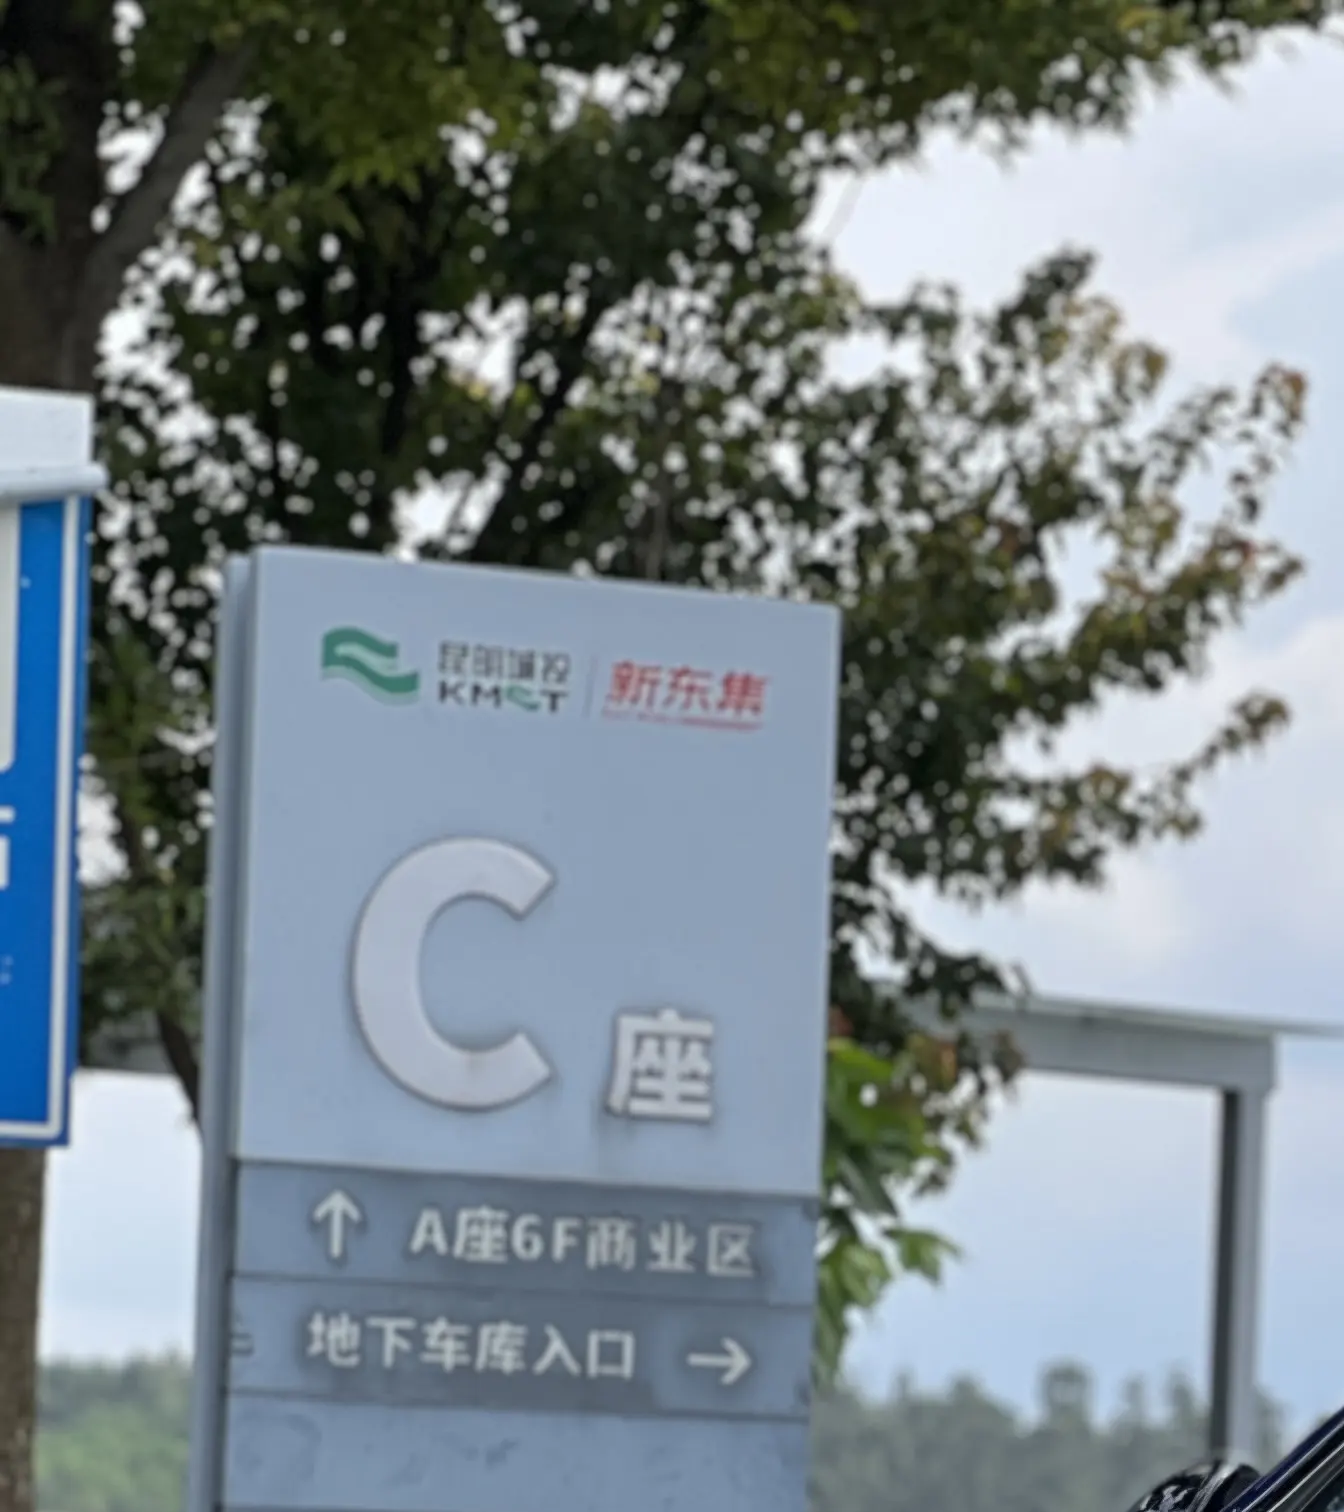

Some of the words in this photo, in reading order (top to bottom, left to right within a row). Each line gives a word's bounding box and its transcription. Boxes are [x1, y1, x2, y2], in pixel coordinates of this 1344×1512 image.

[609, 659, 769, 715] 新东集
[351, 836, 556, 1112] C
[607, 1007, 715, 1121] 座
[409, 1205, 755, 1277] A座6F商业区
[306, 1311, 636, 1379] 地下车库入口
